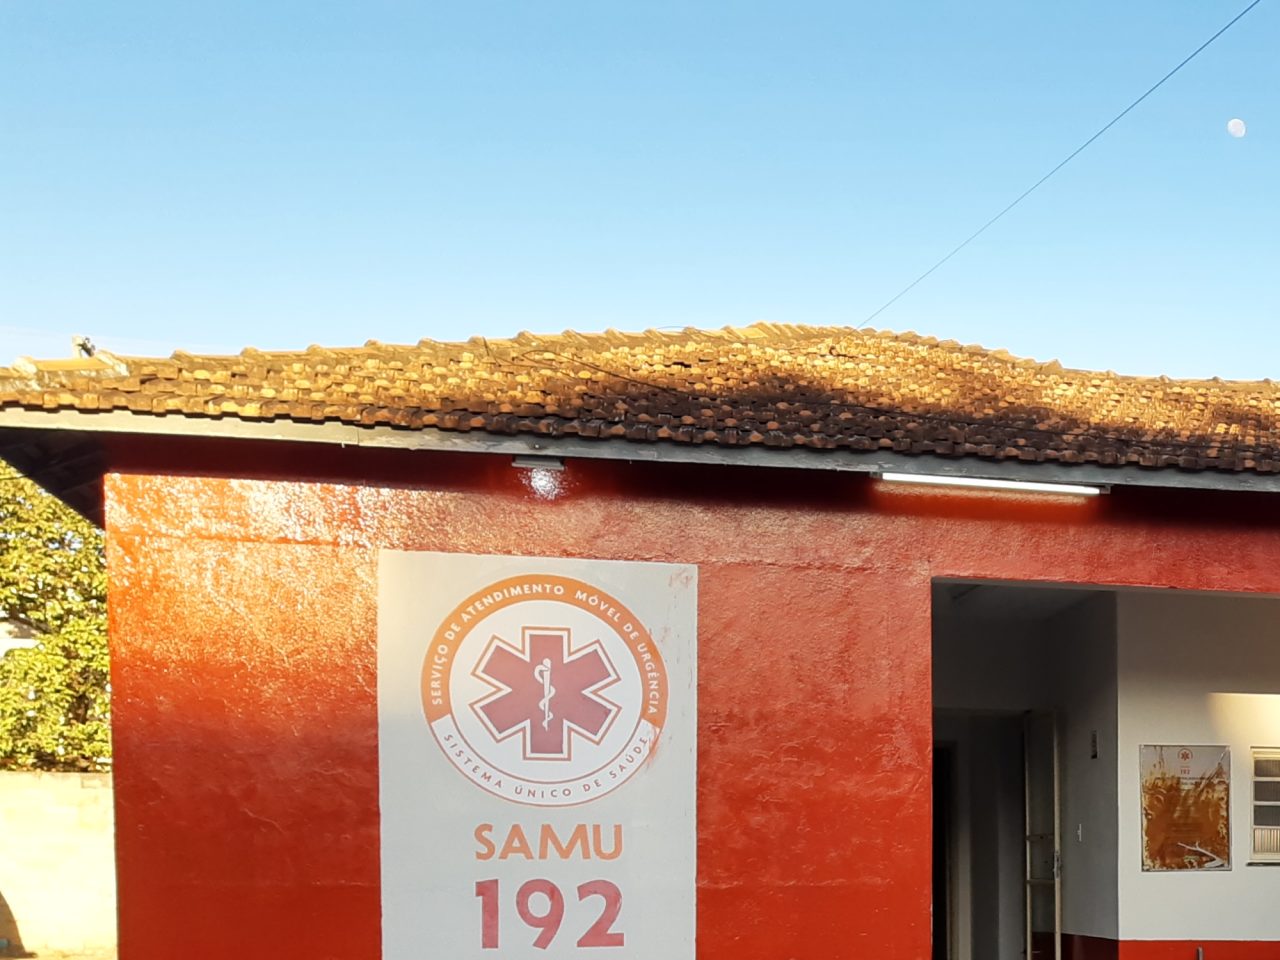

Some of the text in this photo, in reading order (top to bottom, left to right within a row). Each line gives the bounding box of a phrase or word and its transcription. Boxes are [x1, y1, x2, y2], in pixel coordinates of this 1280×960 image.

[431, 584, 660, 714] SERVIÇO DE ATENDIMENTO MÓVEL DE URGÊNCIA
[443, 734, 648, 799] SISTEMA ÚNICO DE SAÚDE
[474, 823, 624, 861] SAMU
[475, 877, 625, 951] 192
